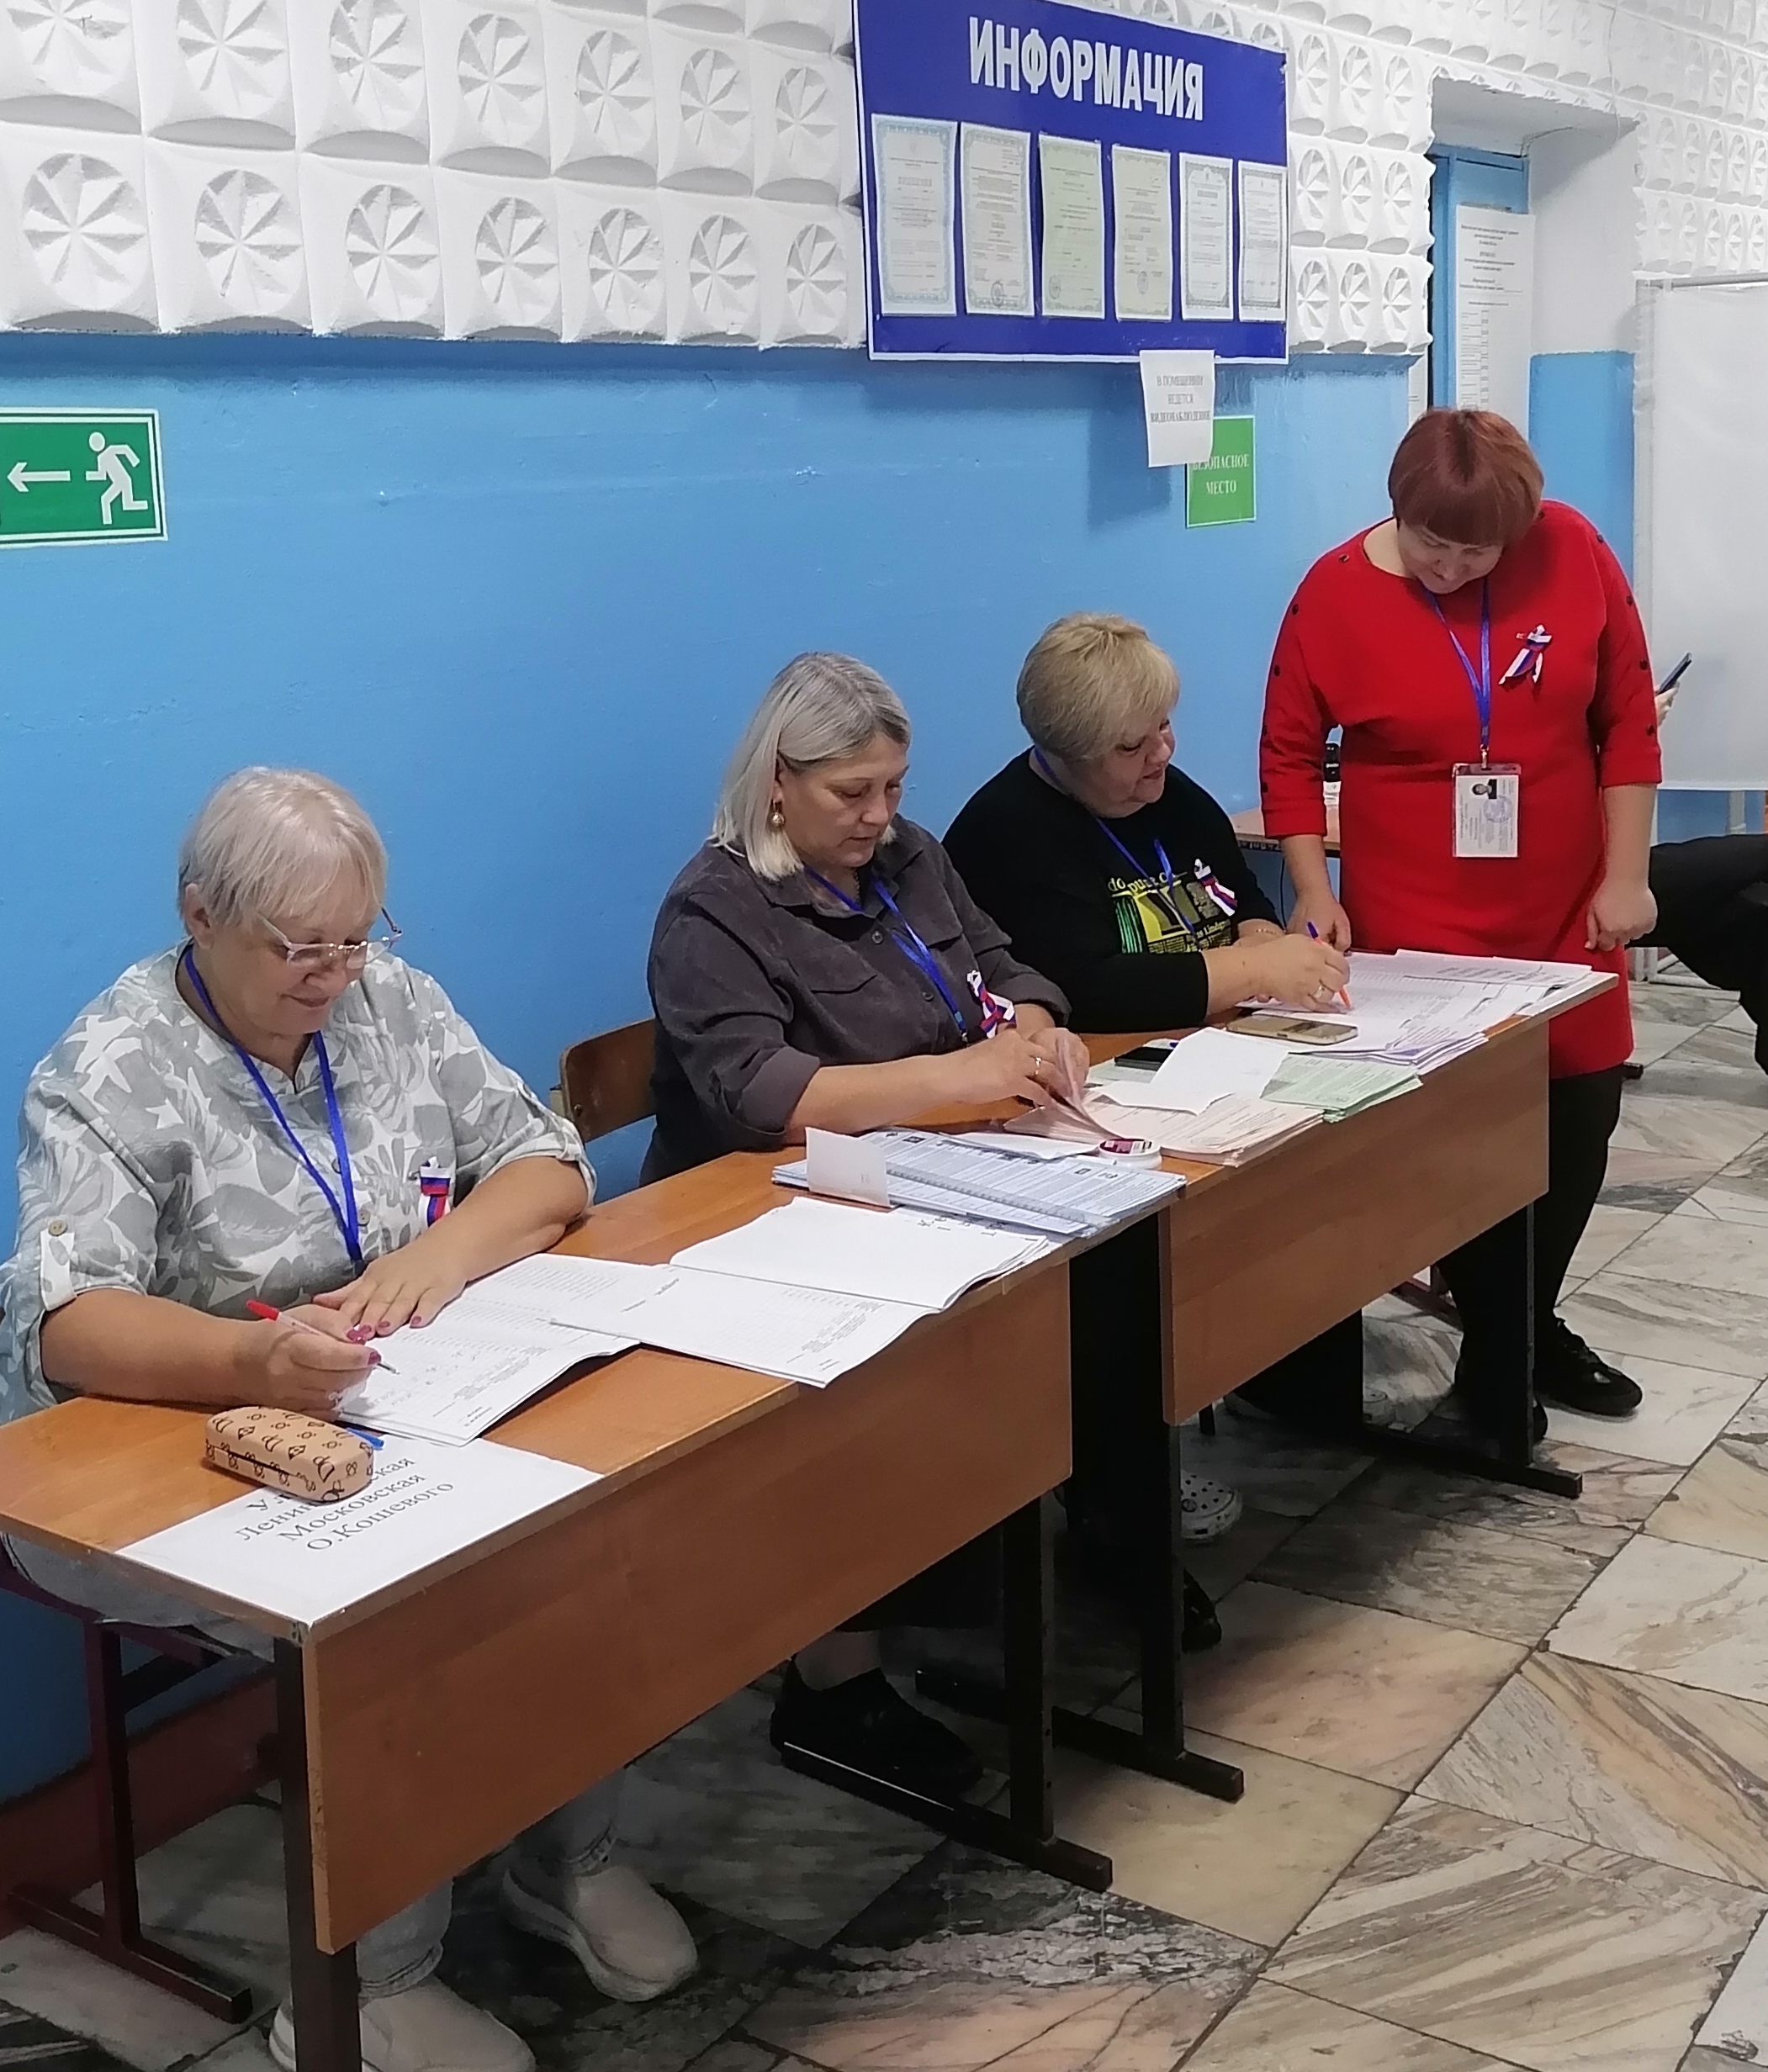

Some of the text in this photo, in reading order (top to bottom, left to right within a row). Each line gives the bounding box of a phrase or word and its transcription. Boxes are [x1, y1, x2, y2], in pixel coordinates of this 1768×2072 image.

[968, 15, 1204, 121] ИНФОРМАЦИЯ
[1205, 480, 1237, 495] МЕСТО
[277, 1472, 427, 1543] Московская
[306, 1481, 455, 1552] О.Кошевого
